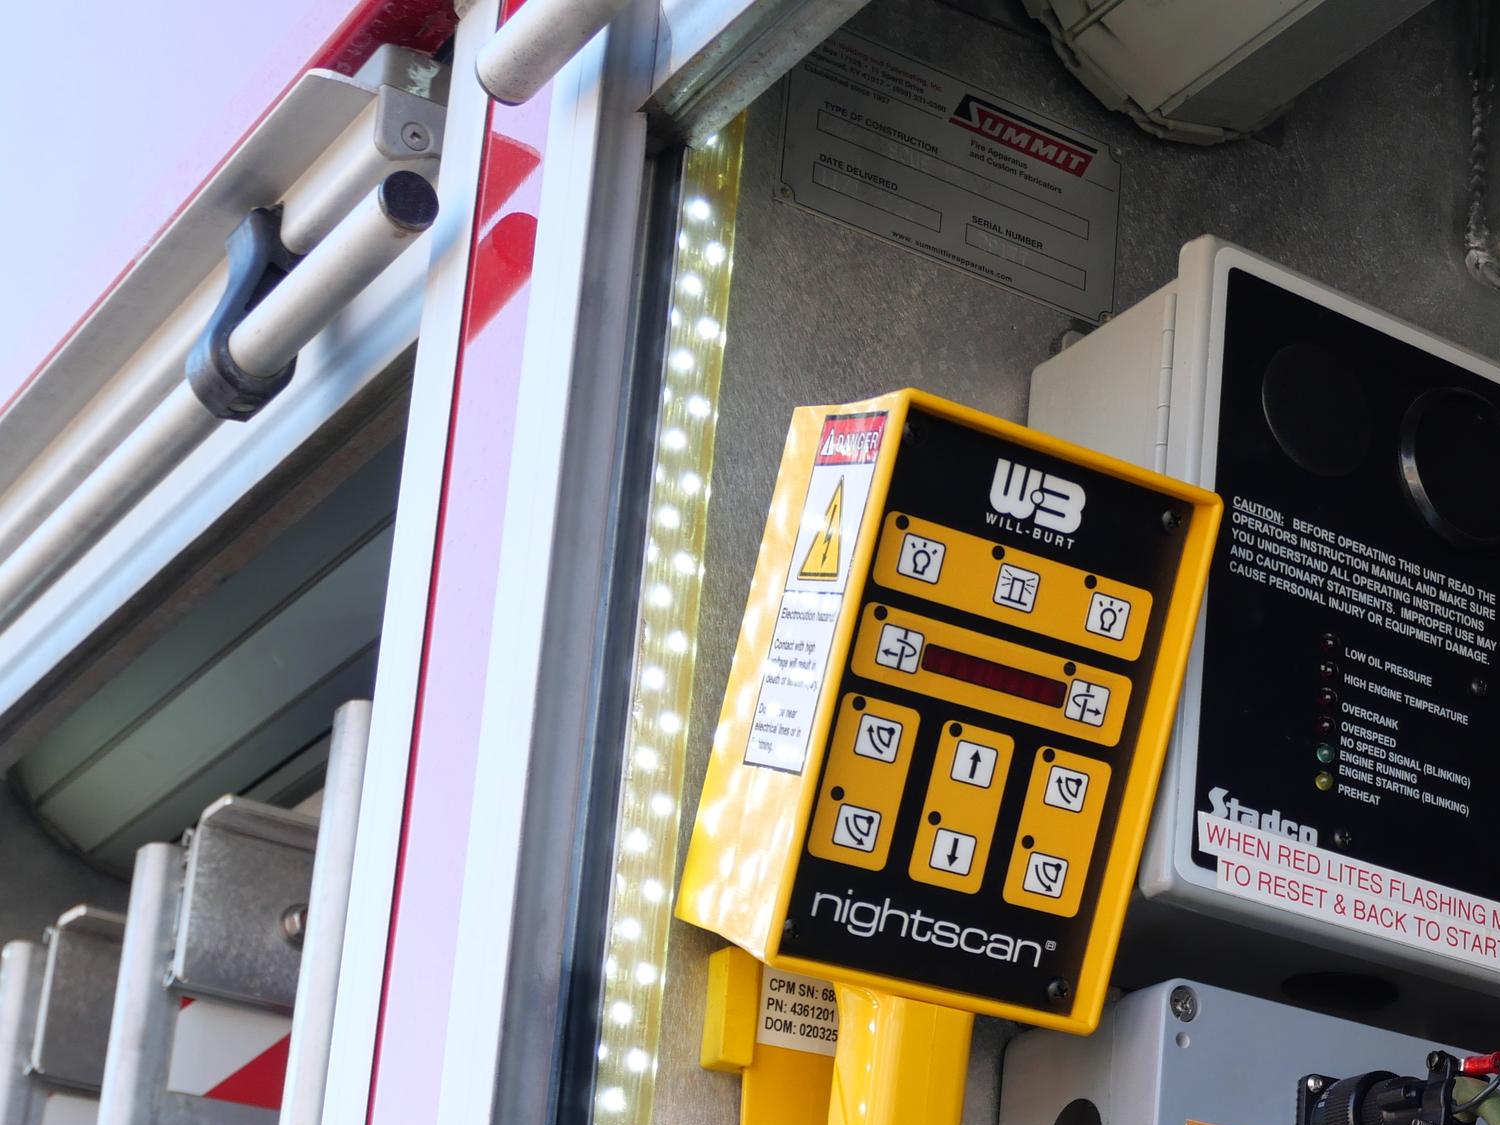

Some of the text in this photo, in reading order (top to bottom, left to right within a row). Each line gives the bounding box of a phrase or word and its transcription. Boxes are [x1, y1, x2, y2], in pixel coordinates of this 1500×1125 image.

[824, 101, 848, 117] TYPE
[850, 111, 863, 123] OF
[865, 117, 939, 154] CONSTRUCTION
[968, 100, 1086, 172] SUMMIT
[819, 153, 844, 170] DATE
[846, 164, 898, 192] DELIVERED
[969, 139, 1028, 170] Fire Apparatus
[969, 150, 1063, 194] and Custom Fabricators
[972, 215, 1043, 250] SERIAL NUMBER
[985, 511, 1075, 551] WILL-BURT
[1233, 495, 1496, 605] CAUTION: BEFORE OPERATING THIS UNIT READ THE
[1232, 512, 1496, 620] OPERATORS INSTRUCTION MANUAL AND MAKE SURE
[1232, 528, 1485, 631] YOU UNDERSTAND ALL OPERATING INSTRUCTIONS
[1229, 561, 1490, 665] CAUSE PERSONAL INJURY OR EQUIPMENT DAMAGE.
[1230, 545, 1497, 652] AND CAUTIONARY STATEMENTS. IMPROPER USE MAY
[1345, 648, 1432, 687] LOW OIL PRESSURE
[1342, 702, 1399, 730] OVERCRANK
[1344, 673, 1468, 725] HIGH ENGINE TEMPERATURE
[1341, 722, 1396, 748] OVERSPEED
[1340, 736, 1471, 789] NO SPEED SIGNAL (BLINKING)
[1340, 750, 1418, 784] ENGINE RUNNING
[1338, 784, 1381, 805] PREHEAT
[1339, 764, 1470, 817] ENGINE STARTING (BLINKING)
[1208, 787, 1318, 847] Stadco
[1206, 821, 1271, 861] WHEN
[1277, 844, 1321, 875] RED
[1327, 859, 1383, 894] LITES
[1389, 878, 1487, 926] FLASHING
[1221, 860, 1251, 887] TO
[1258, 871, 1328, 909] RESET
[1333, 893, 1347, 917] &
[1353, 898, 1408, 934] BACK
[1413, 916, 1441, 942] TO
[766, 997, 835, 1022] PN: 4361201
[769, 978, 837, 1004] CPM SN: 68
[764, 1016, 839, 1042] DOM: 020325
